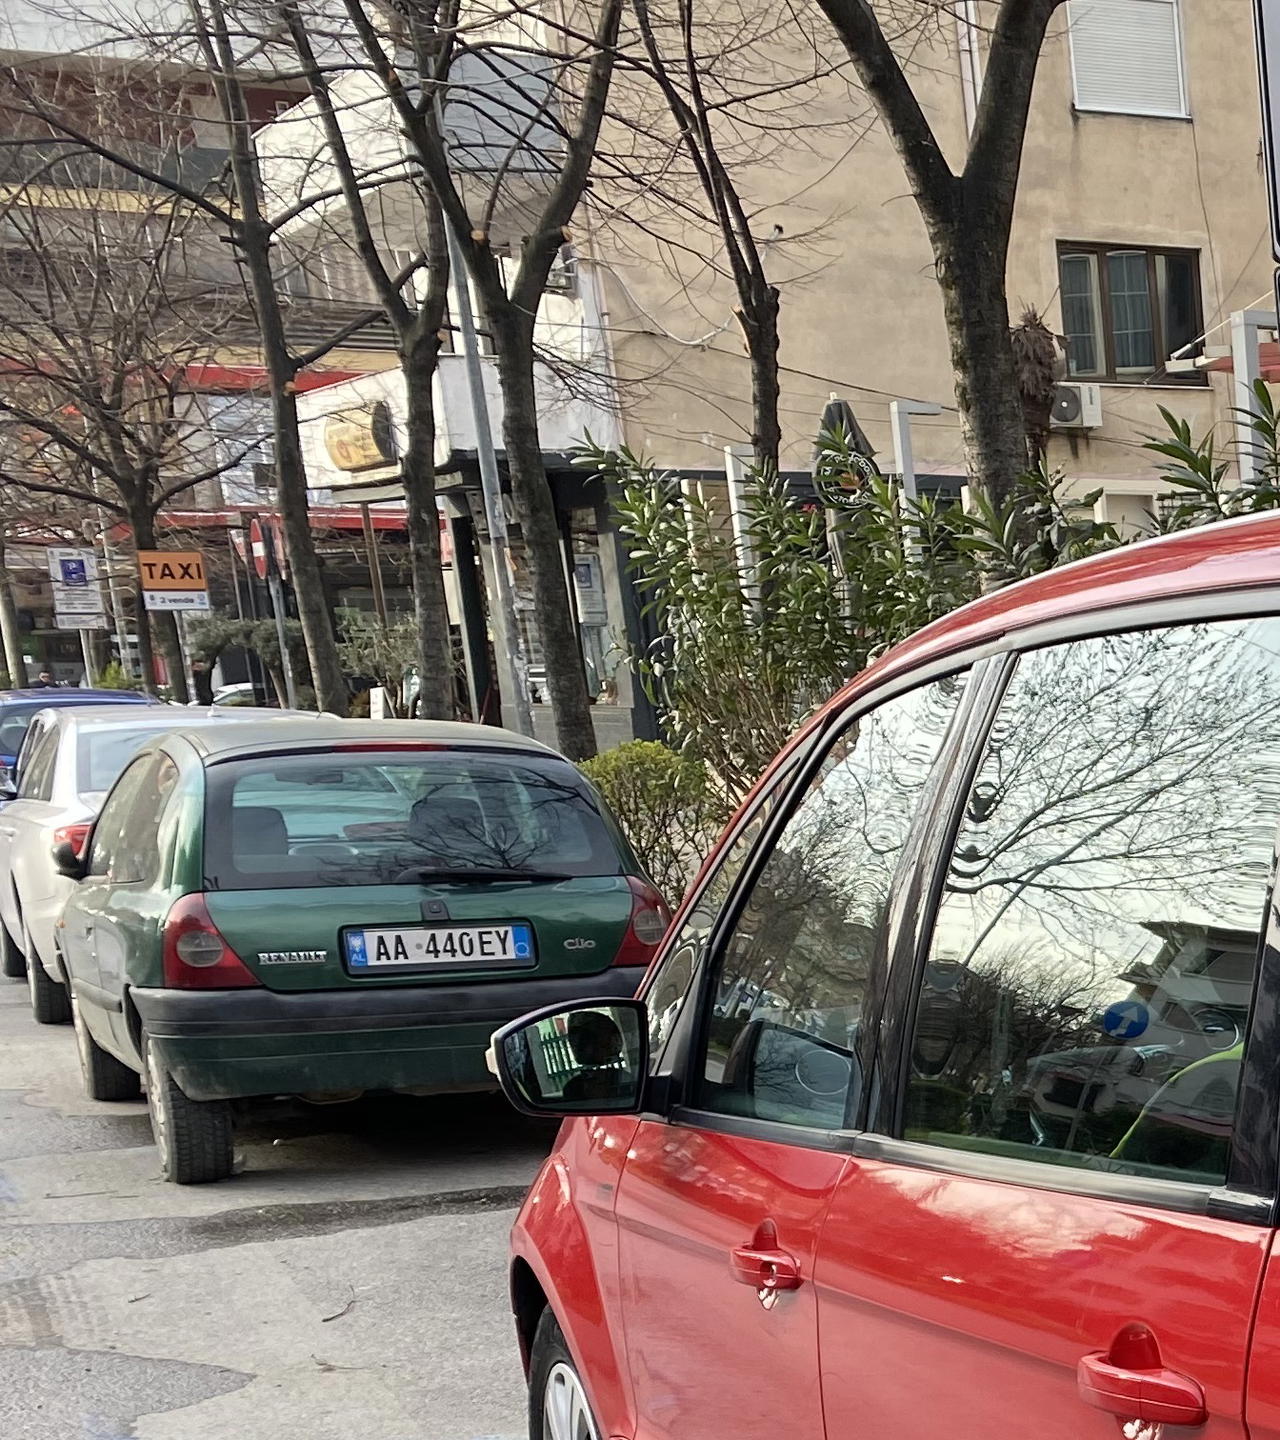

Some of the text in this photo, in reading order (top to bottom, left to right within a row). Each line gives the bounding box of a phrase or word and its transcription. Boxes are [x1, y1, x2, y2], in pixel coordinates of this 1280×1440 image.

[142, 562, 203, 580] TAXI
[375, 929, 512, 961] AA 440EY
[563, 938, 597, 951] Clio
[257, 950, 327, 965] RENAULT
[350, 953, 366, 963] AL
